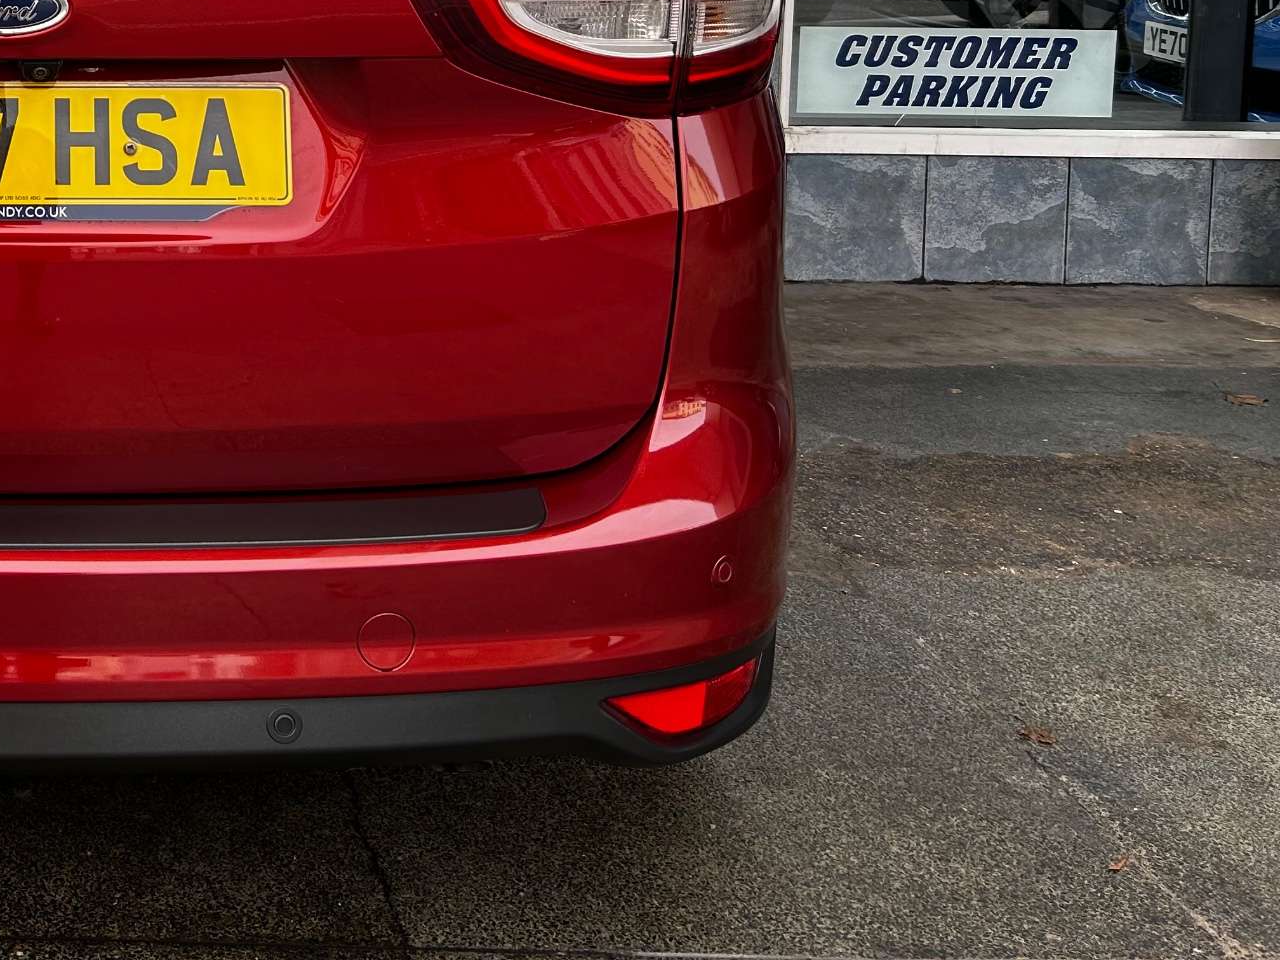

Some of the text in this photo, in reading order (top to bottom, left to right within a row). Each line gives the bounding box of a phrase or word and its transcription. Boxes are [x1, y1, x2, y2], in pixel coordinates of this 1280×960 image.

[835, 34, 1078, 70] CUSTOMER
[855, 74, 1054, 109] PARKING
[54, 97, 246, 187] HSA
